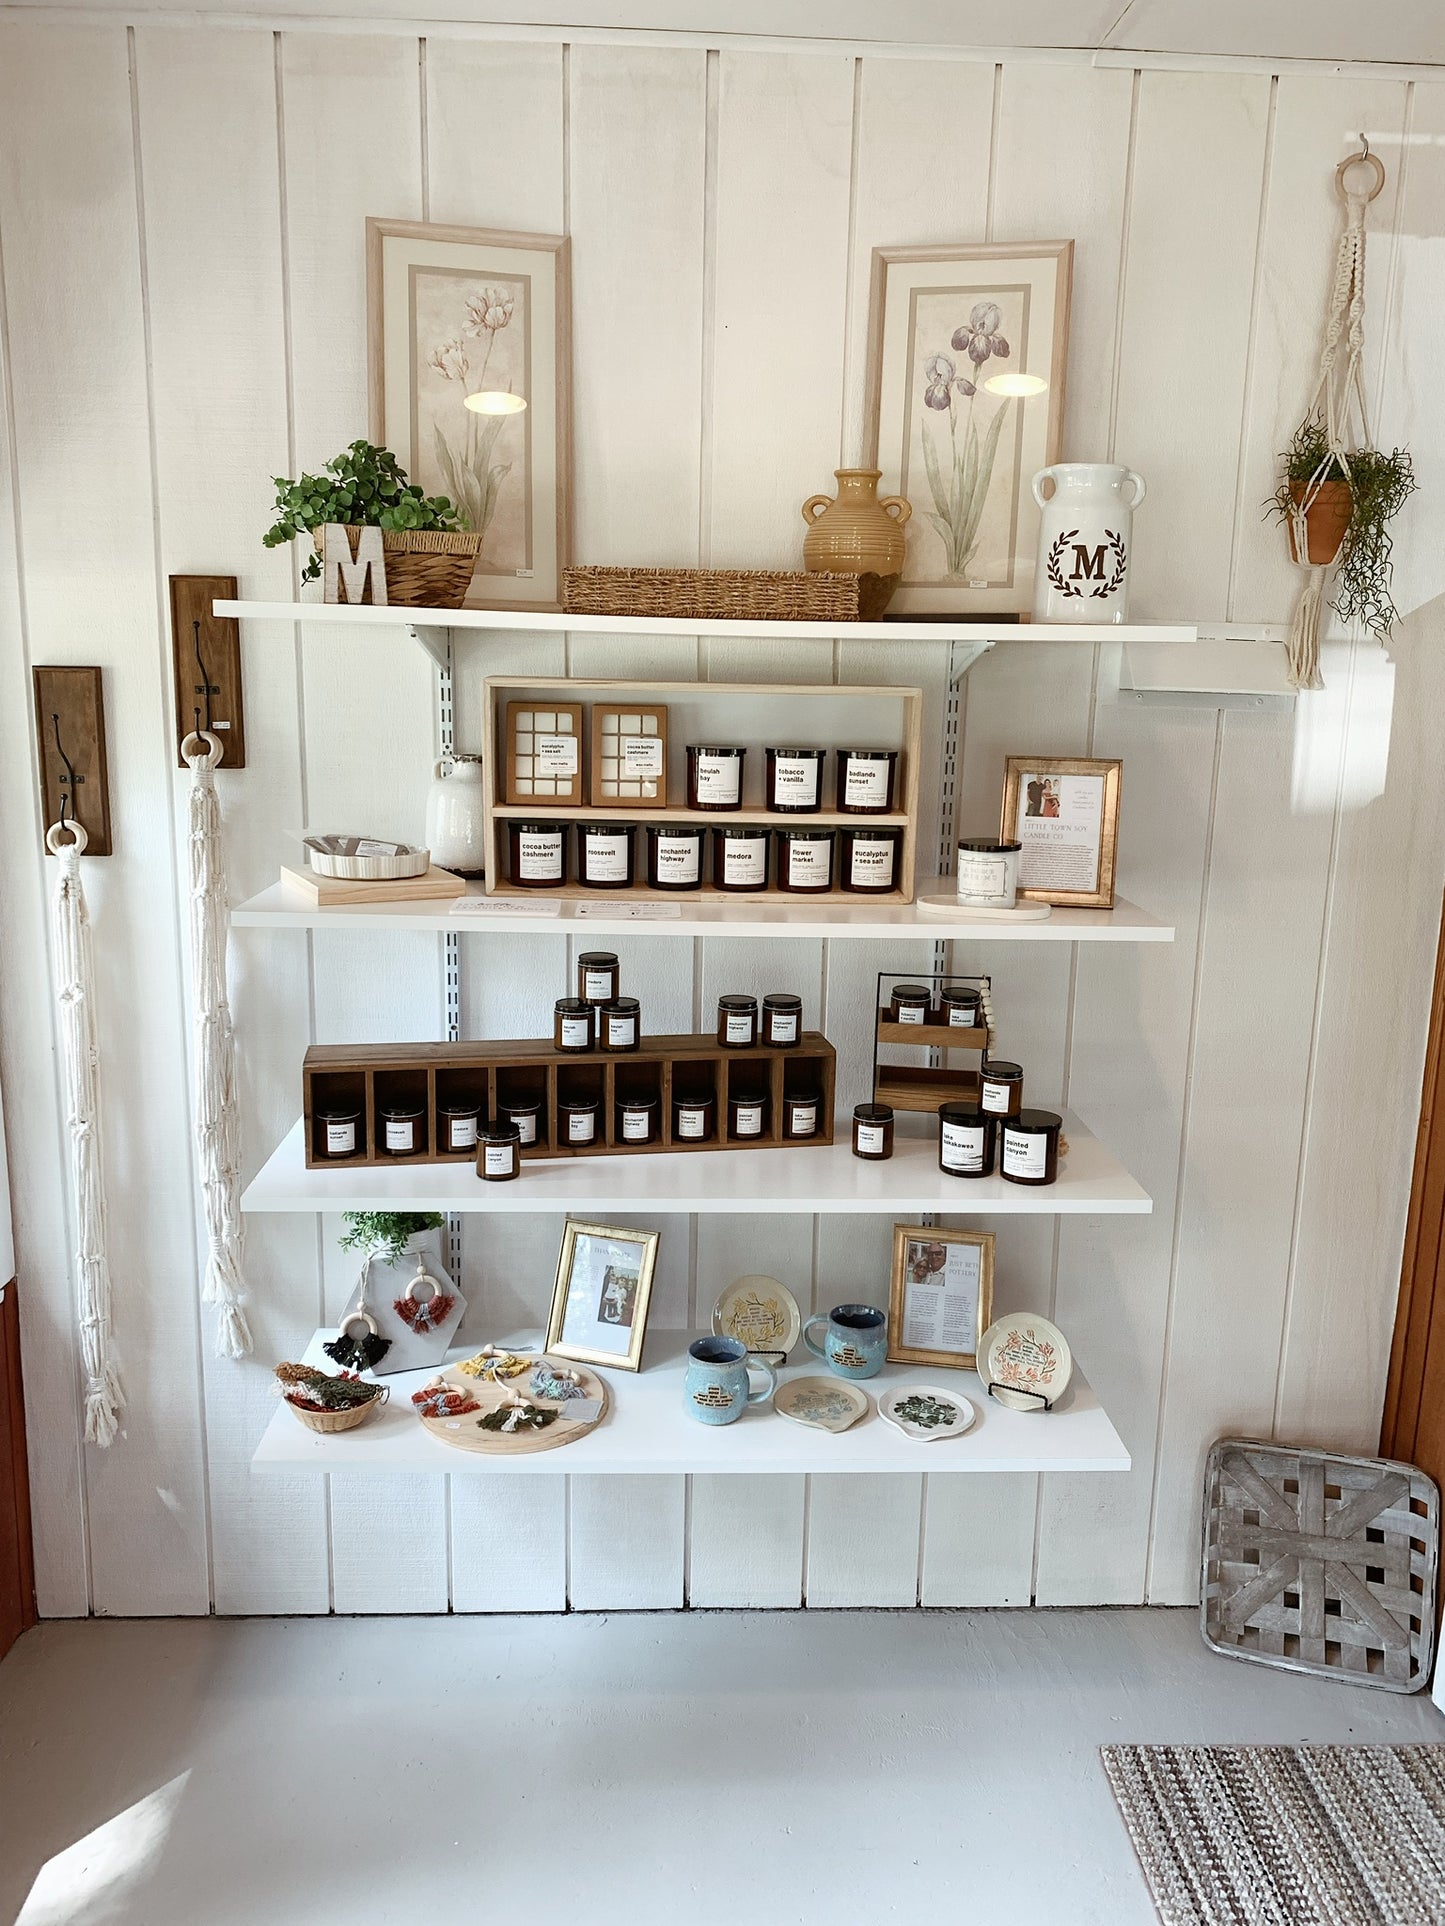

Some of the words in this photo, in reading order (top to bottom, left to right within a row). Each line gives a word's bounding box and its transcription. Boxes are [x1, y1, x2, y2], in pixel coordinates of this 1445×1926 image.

[323, 523, 388, 606] M
[1069, 545, 1108, 580] M
[1023, 832, 1050, 840] CANDLE
[855, 850, 889, 858] eucalyptus
[1006, 1140, 1029, 1149] painted
[1006, 1147, 1028, 1155] canyon
